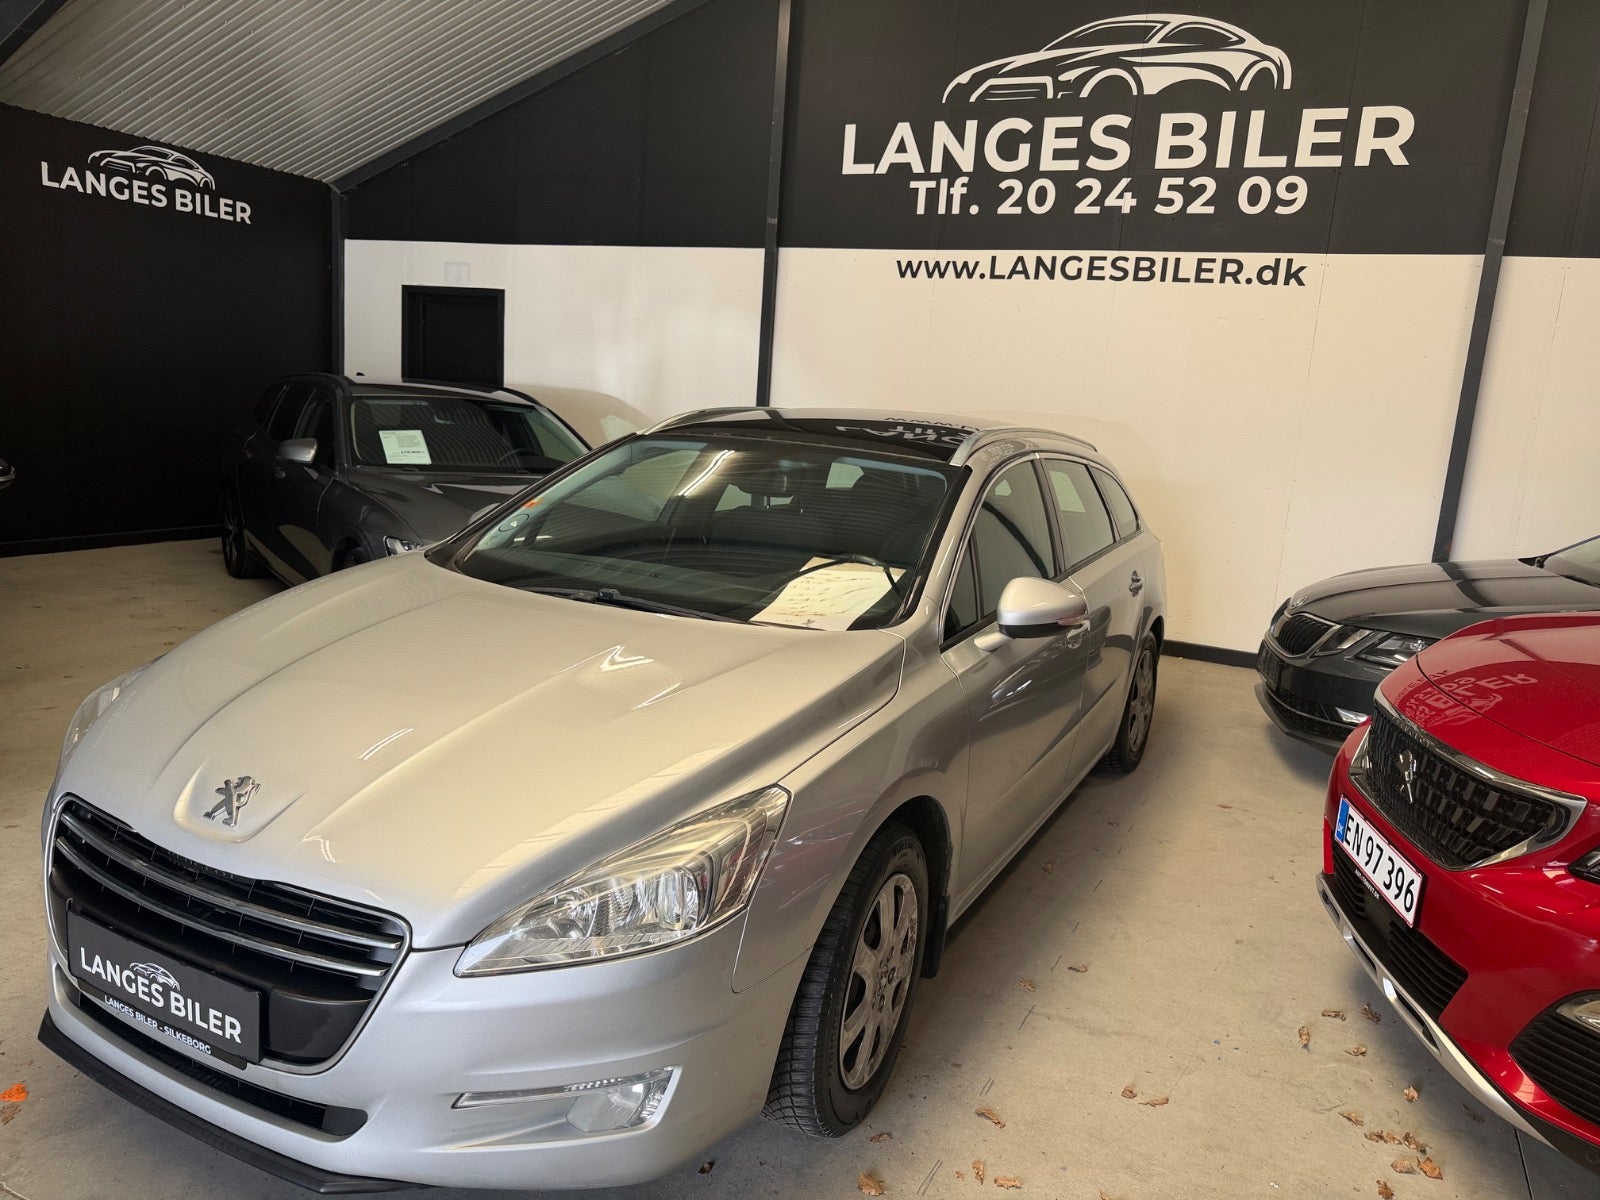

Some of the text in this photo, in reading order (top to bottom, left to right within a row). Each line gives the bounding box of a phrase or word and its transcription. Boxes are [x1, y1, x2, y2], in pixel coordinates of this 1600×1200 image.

[841, 106, 1415, 175] LANGES BILER
[40, 160, 252, 225] LANGES BILER
[910, 175, 1308, 215] Tlf. 20 24 52 09
[896, 255, 1308, 287] www.LANGESBILER.dk
[1344, 812, 1364, 857] EN
[1364, 835, 1384, 875] 97
[1383, 855, 1415, 913] 396
[80, 946, 242, 1044] LANGES BILER
[104, 994, 135, 1018] LANGES
[135, 1012, 158, 1030] BILER
[163, 1025, 213, 1055] SILKEBORG
